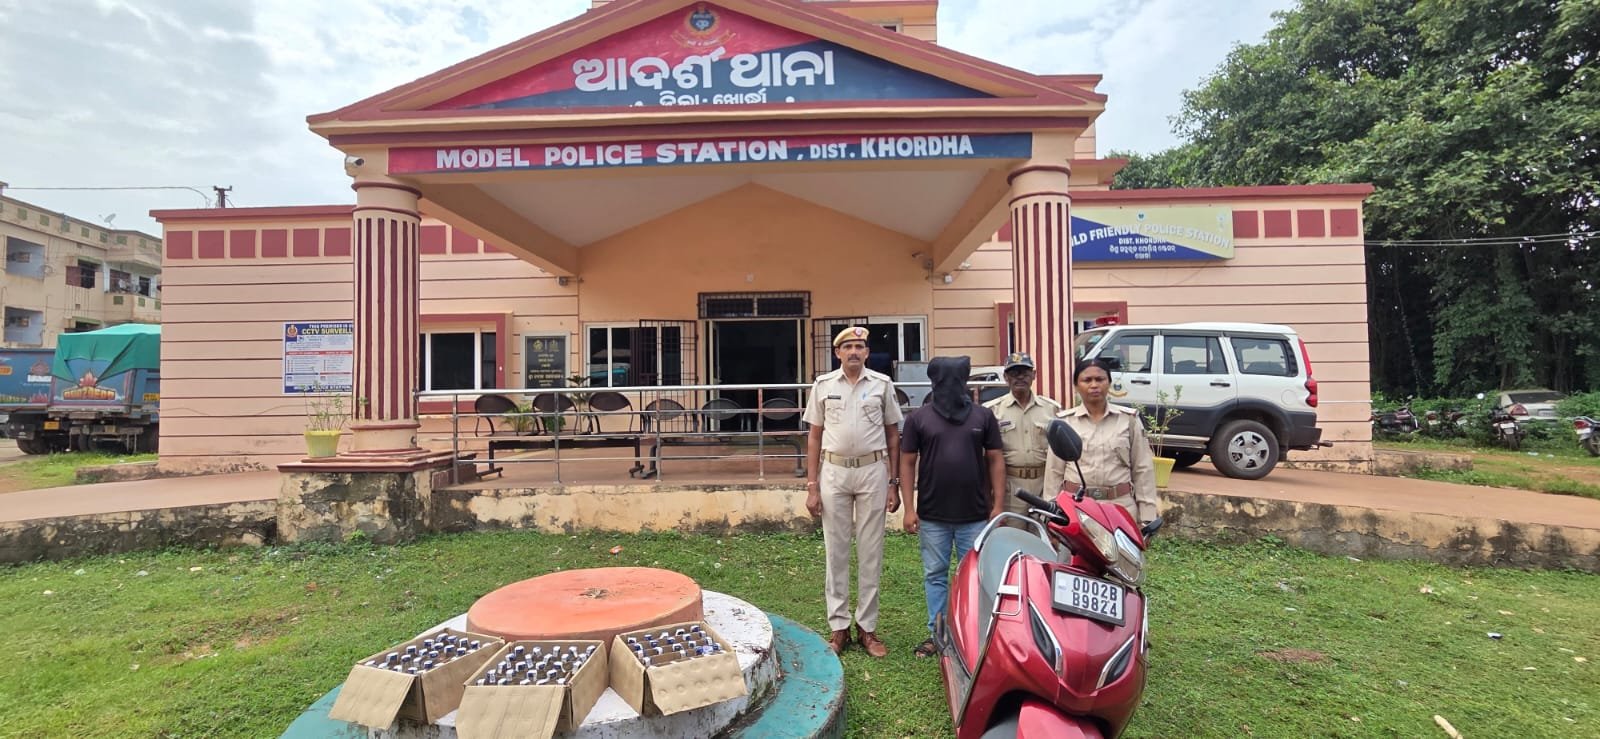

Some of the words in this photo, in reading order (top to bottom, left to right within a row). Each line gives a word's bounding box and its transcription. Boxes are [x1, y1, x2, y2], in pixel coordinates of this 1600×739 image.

[572, 47, 725, 91] ଆଦର୍ଶ
[730, 51, 834, 87] ଥାନା
[436, 147, 530, 169] MODEL
[545, 144, 643, 167] POLICE
[656, 140, 788, 163] STATION
[810, 143, 856, 159] DIST.
[861, 134, 974, 158] KHORDHA
[1090, 223, 1141, 241] FRIENDLY
[1144, 223, 1184, 237] POLICE
[1186, 228, 1231, 249] STATION
[1073, 577, 1118, 602] OD02B
[1072, 591, 1117, 617] B9824
